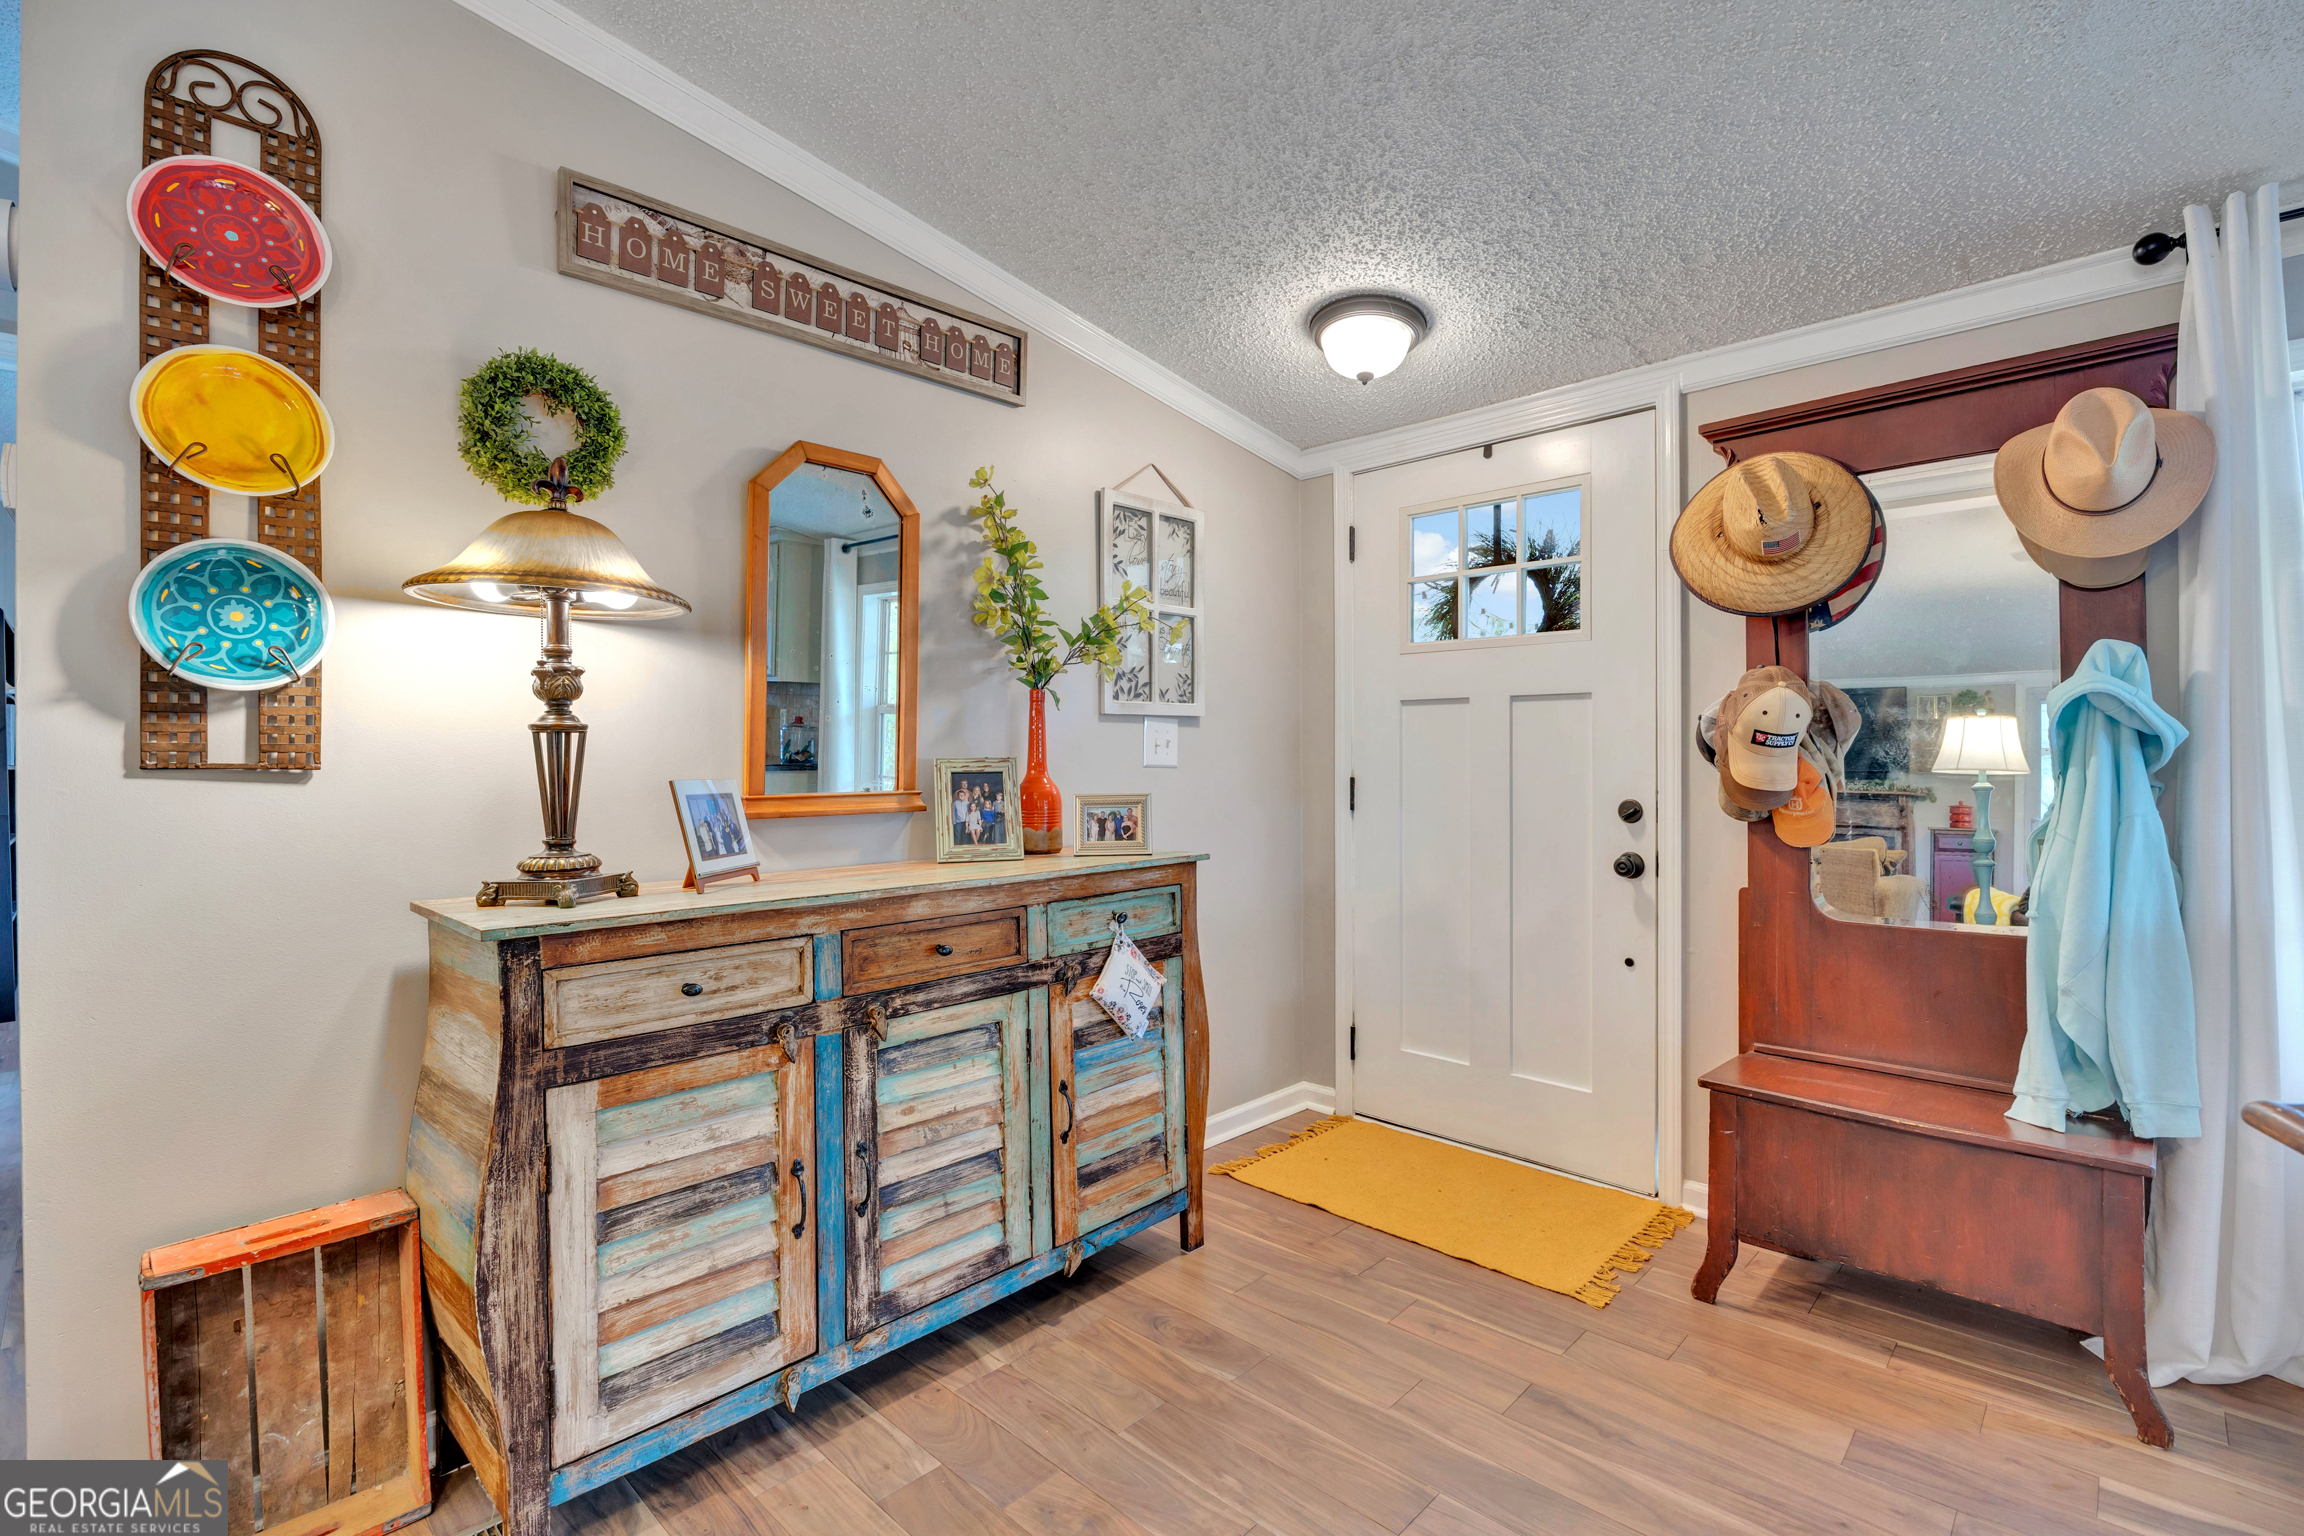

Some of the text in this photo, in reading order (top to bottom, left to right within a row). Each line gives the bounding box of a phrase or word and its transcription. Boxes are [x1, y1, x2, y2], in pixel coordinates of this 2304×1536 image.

[581, 221, 719, 282] HOME
[761, 280, 895, 337] SWEET
[924, 333, 1011, 375] HOME
